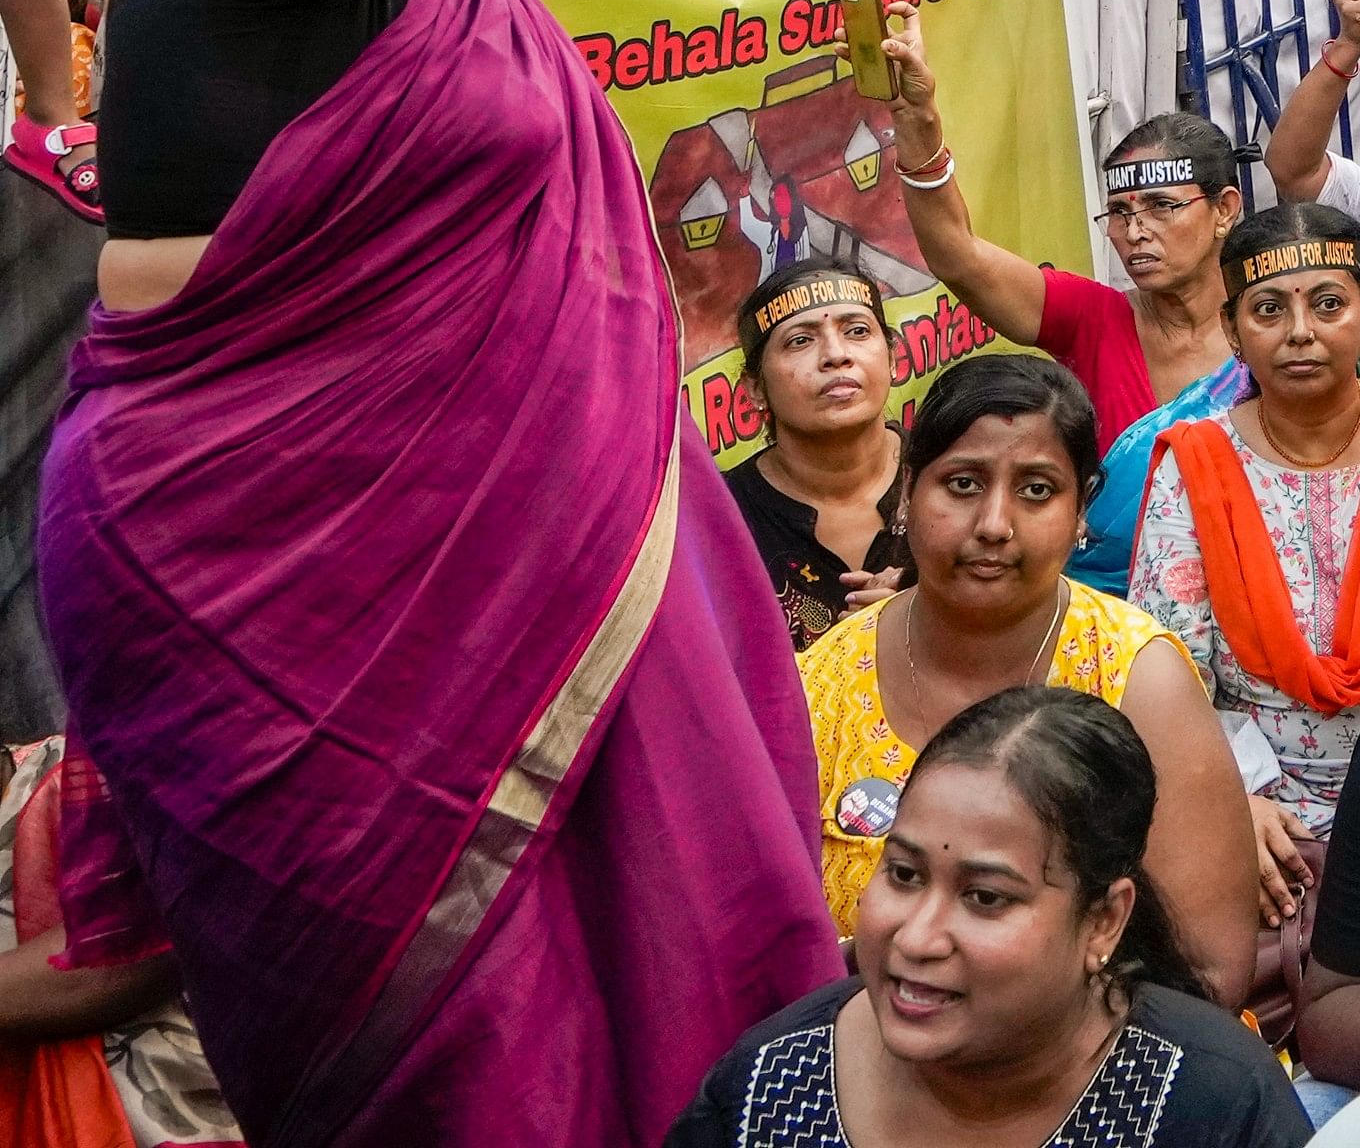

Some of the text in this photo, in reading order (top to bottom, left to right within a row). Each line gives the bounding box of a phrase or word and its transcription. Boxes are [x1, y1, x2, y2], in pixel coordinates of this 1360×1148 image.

[573, 8, 768, 93] Behala
[1107, 158, 1194, 191] WANT JUSTICE
[1242, 241, 1355, 284] WE DEMAND FOR JUSTICE
[755, 279, 874, 333] WE DEMAND FOR JUSTICE
